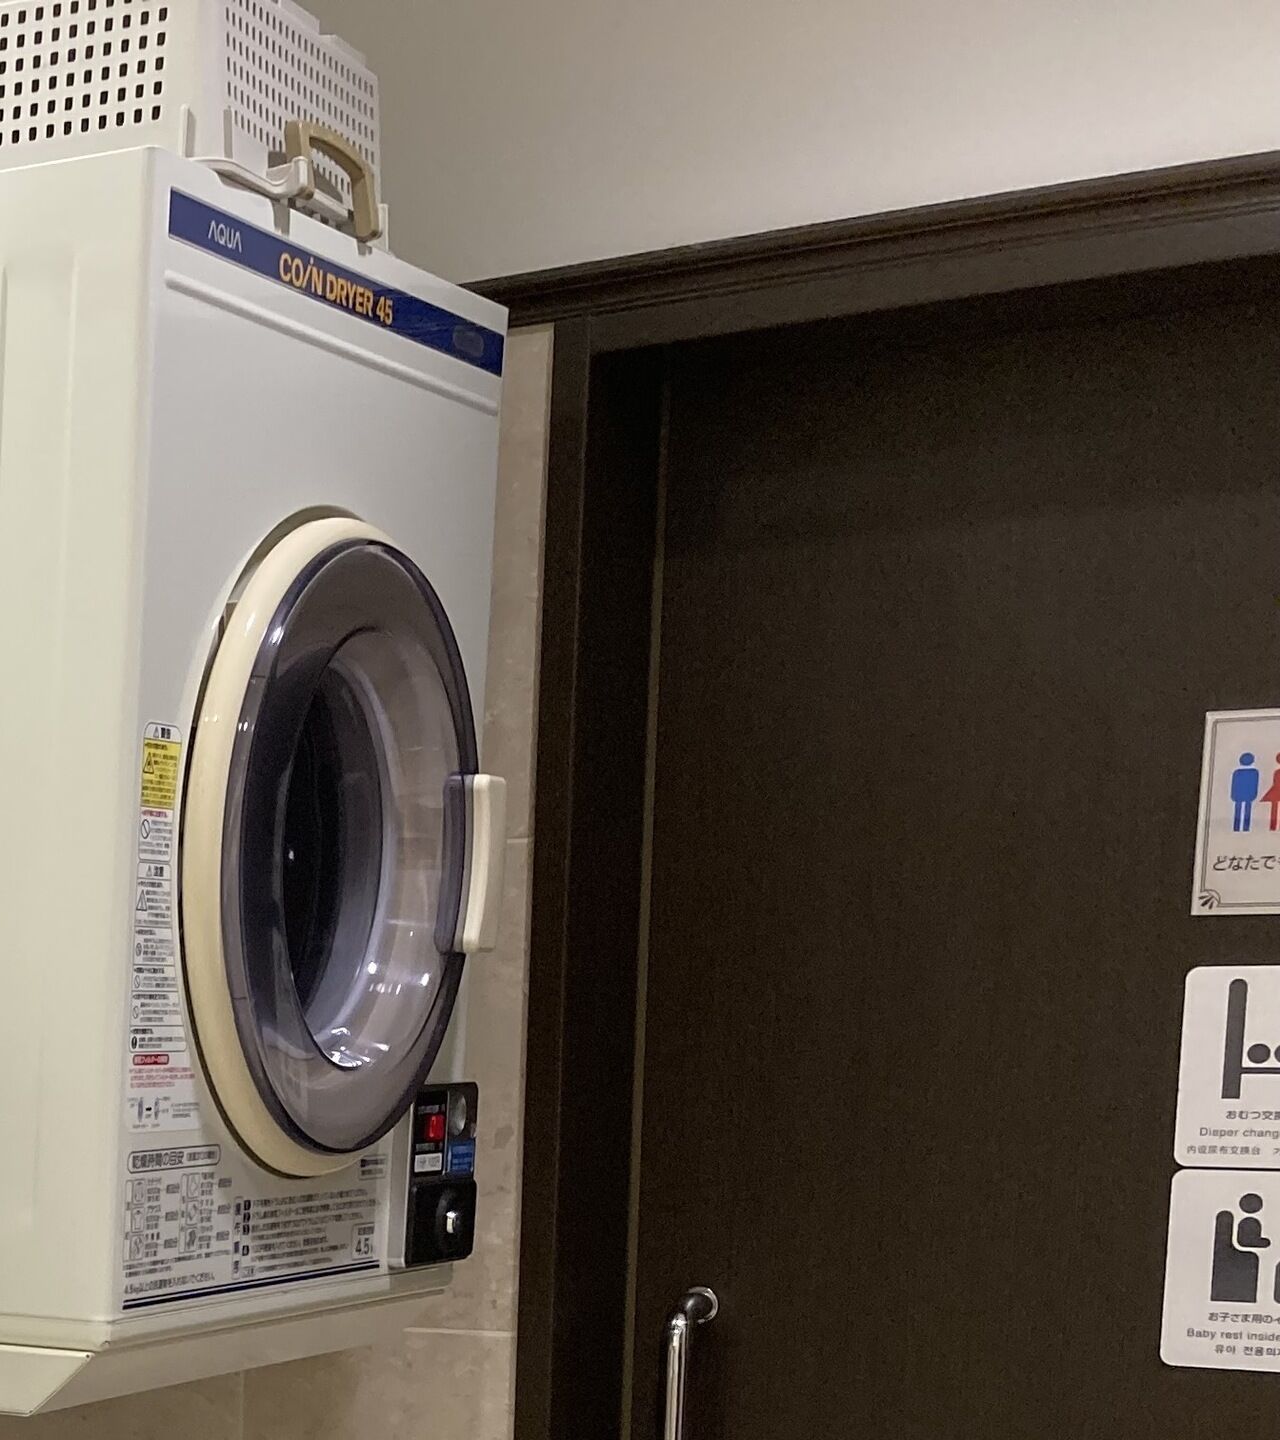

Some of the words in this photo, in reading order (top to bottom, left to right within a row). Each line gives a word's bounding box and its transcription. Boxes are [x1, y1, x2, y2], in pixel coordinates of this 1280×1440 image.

[208, 219, 243, 253] AQUA
[326, 272, 375, 318] DRYER
[375, 295, 395, 326] 45
[1199, 1127, 1239, 1138] Diaper
[1186, 1328, 1216, 1340] Baby
[1220, 1329, 1243, 1341] rest
